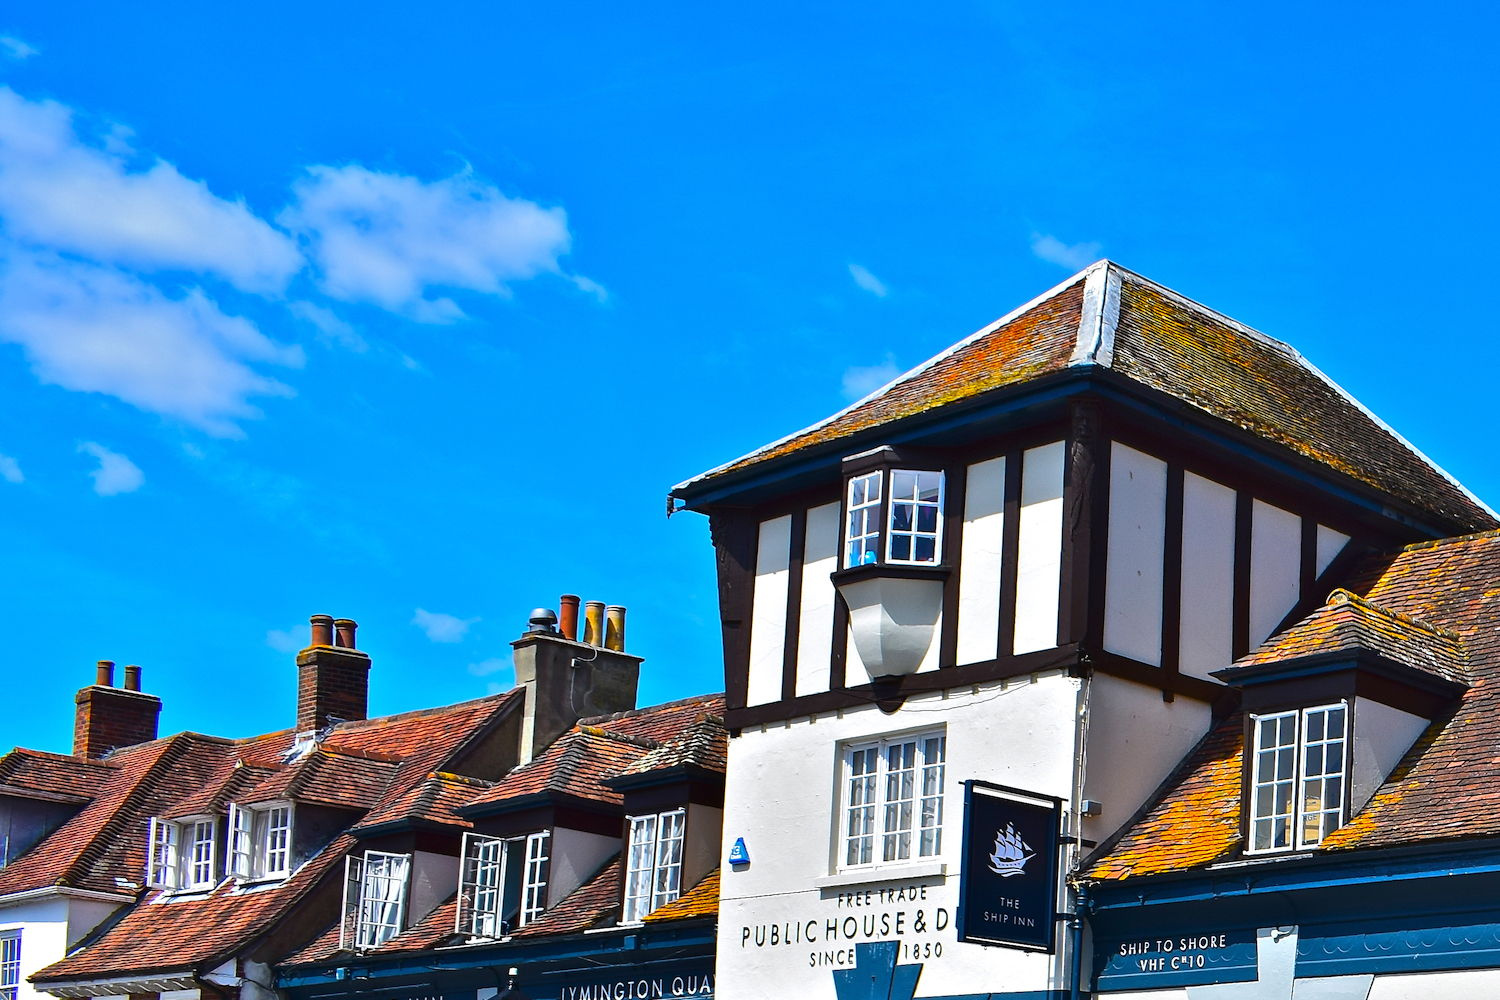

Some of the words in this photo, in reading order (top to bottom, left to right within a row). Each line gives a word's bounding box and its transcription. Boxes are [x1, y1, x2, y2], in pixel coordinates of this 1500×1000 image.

[838, 890, 872, 908] FREE
[879, 885, 927, 904] TRADE
[1000, 897, 1020, 909] THE
[742, 920, 818, 948] PUBLIC
[825, 912, 905, 940] HOUSE
[914, 909, 927, 933] &
[984, 911, 1009, 923] SHIP
[1013, 916, 1035, 927] INN
[809, 949, 854, 967] SINCE
[904, 942, 943, 960] 1850
[1119, 941, 1151, 957] SHIP
[1156, 940, 1174, 953] TO
[1179, 934, 1226, 950] SHORE
[1140, 956, 1166, 971] VHF
